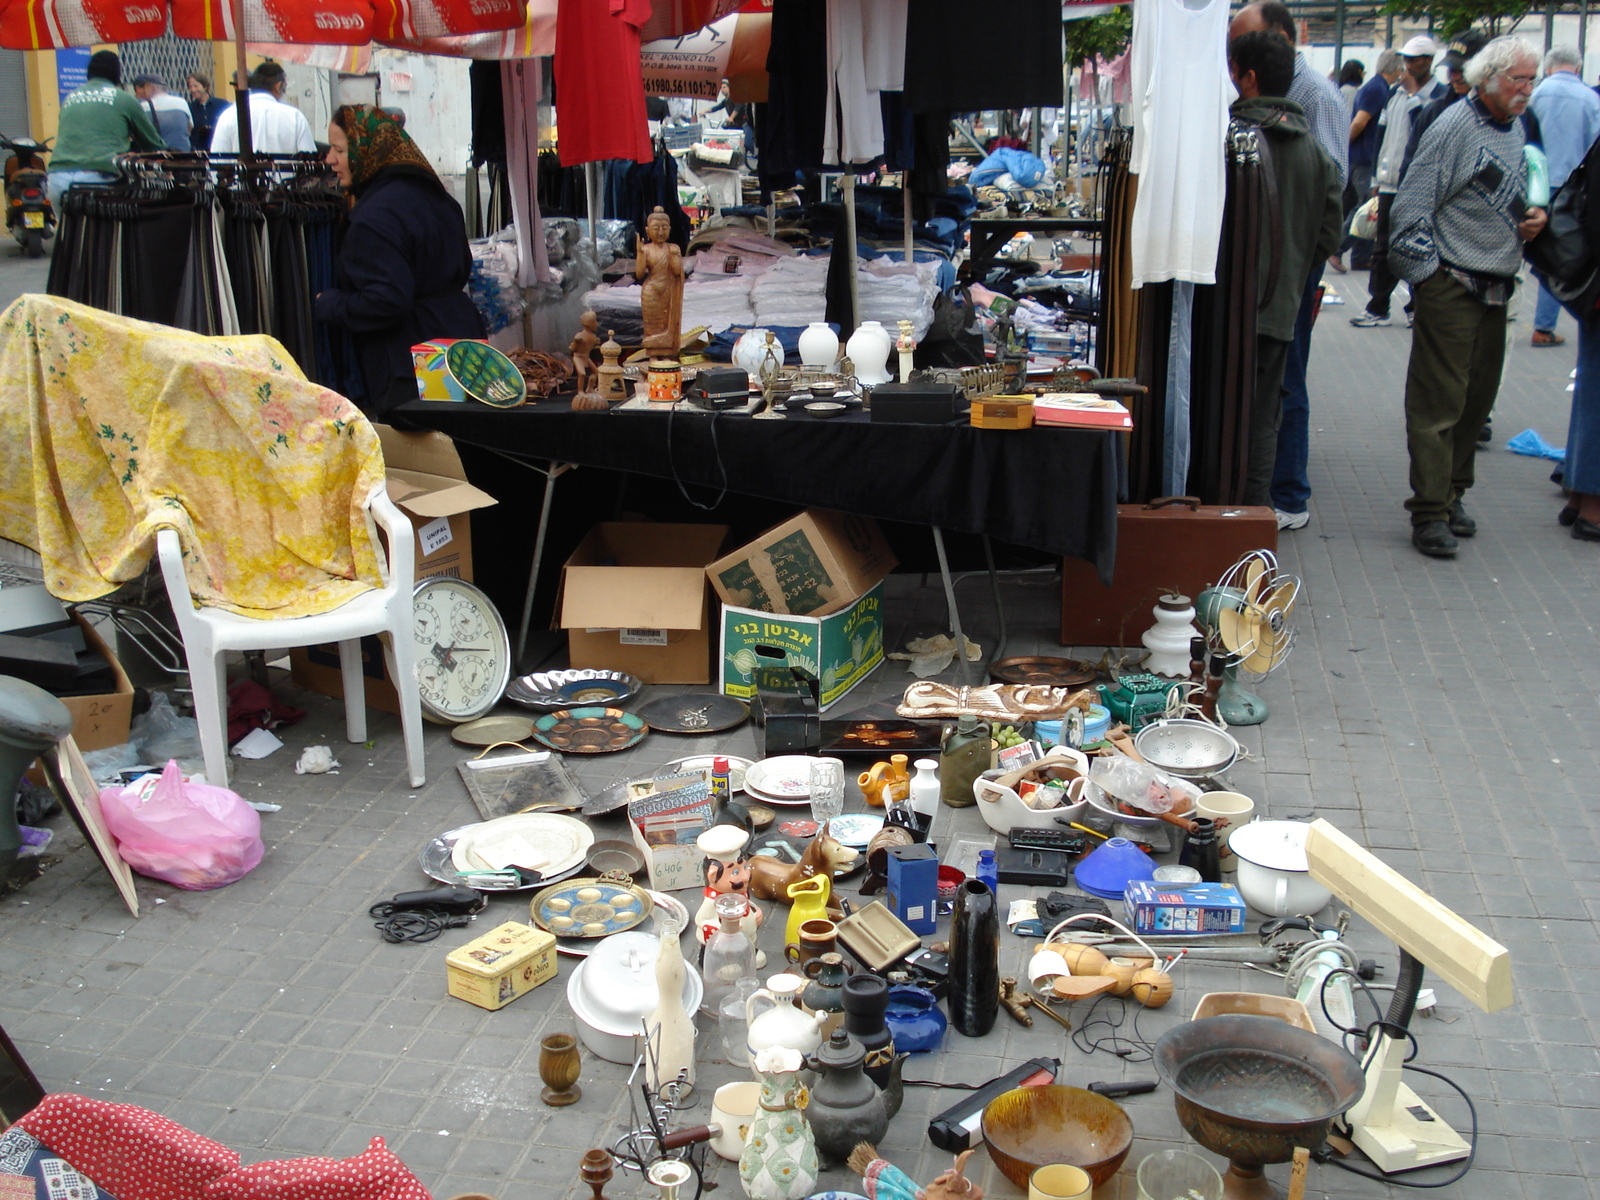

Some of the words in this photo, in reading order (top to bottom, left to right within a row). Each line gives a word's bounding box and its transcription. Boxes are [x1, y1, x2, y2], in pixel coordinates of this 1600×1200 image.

[426, 525, 447, 540] UNIPAL
[734, 623, 759, 635] בני
[764, 623, 813, 647] אביטן
